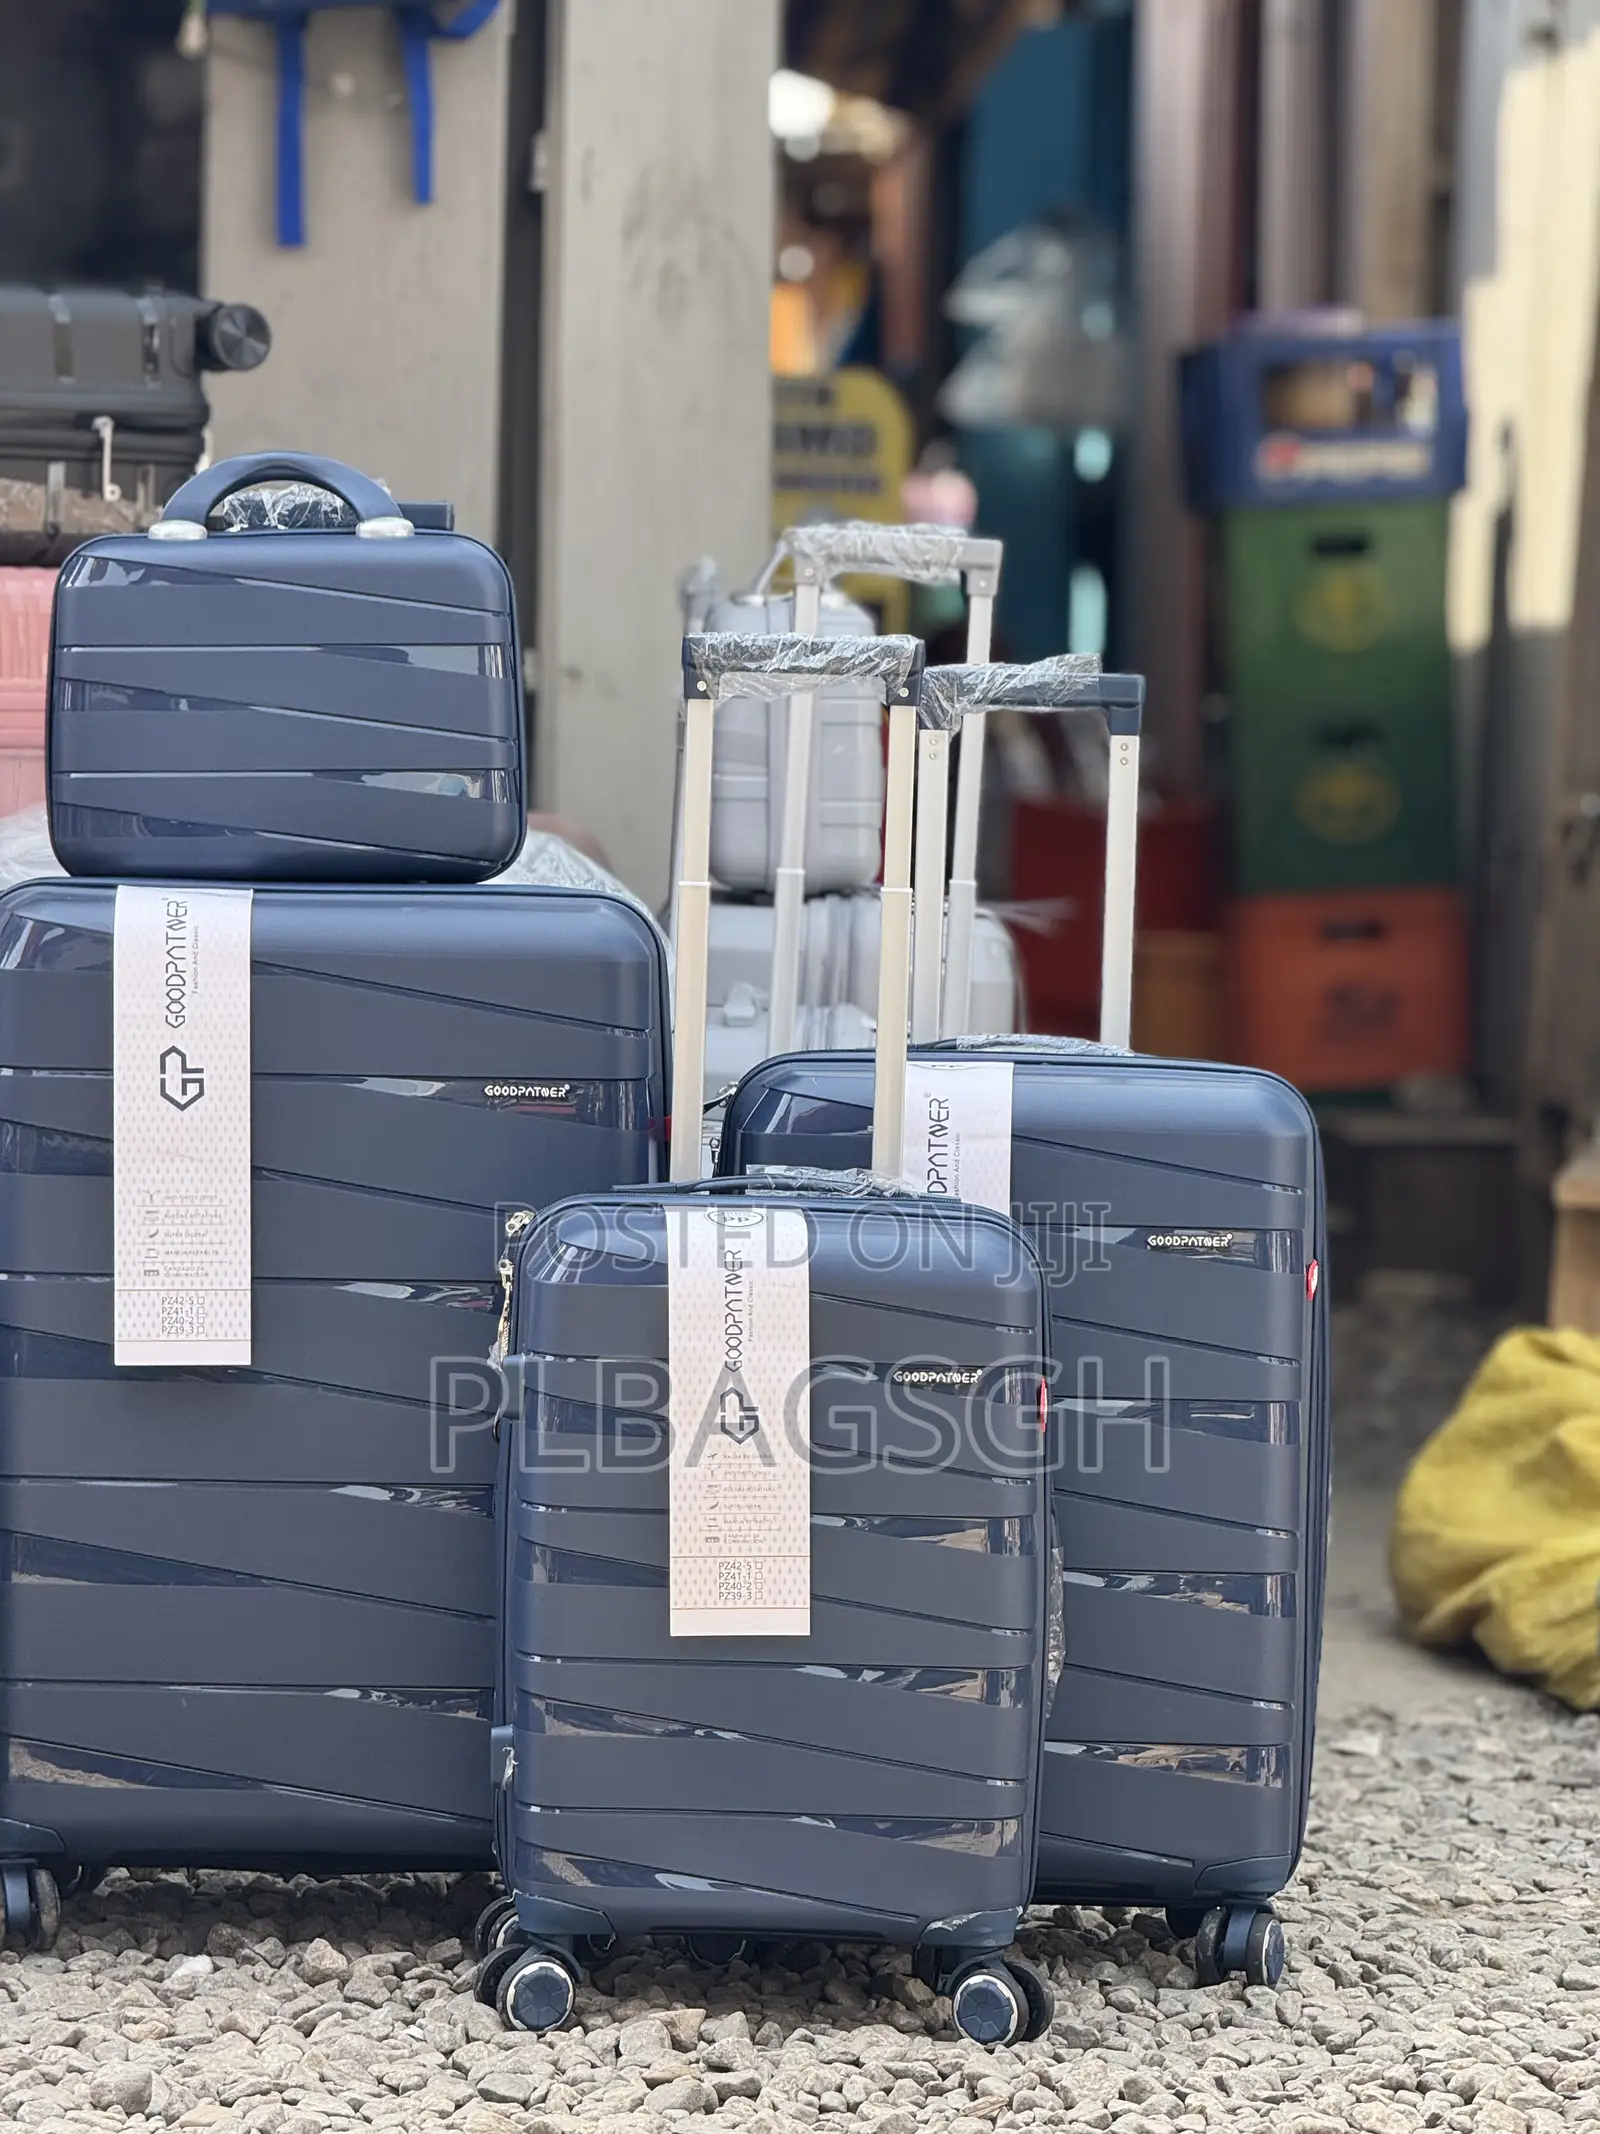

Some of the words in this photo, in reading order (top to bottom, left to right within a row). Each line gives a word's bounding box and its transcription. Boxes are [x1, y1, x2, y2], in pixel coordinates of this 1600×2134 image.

[191, 925, 199, 950] Classic
[165, 900, 187, 1029] GOODPATNER
[191, 966, 199, 994] Fashion
[484, 1085, 567, 1098] GOODPATNER
[927, 1098, 949, 1194] DPATNER
[953, 1132, 961, 1157] Classic
[1147, 1235, 1229, 1247] GOODPATNER
[161, 1306, 194, 1315] PZ41-1
[724, 1249, 743, 1373] GOODPATNER
[161, 1316, 194, 1325] PZ40-2
[161, 1326, 194, 1335] PZ39-3
[892, 1371, 978, 1383] GOODPATNER
[718, 1561, 752, 1570] PZ42-5
[718, 1571, 752, 1580] PZ41-1
[718, 1582, 752, 1591] PZ40-2
[718, 1591, 752, 1600] PZ39-3
